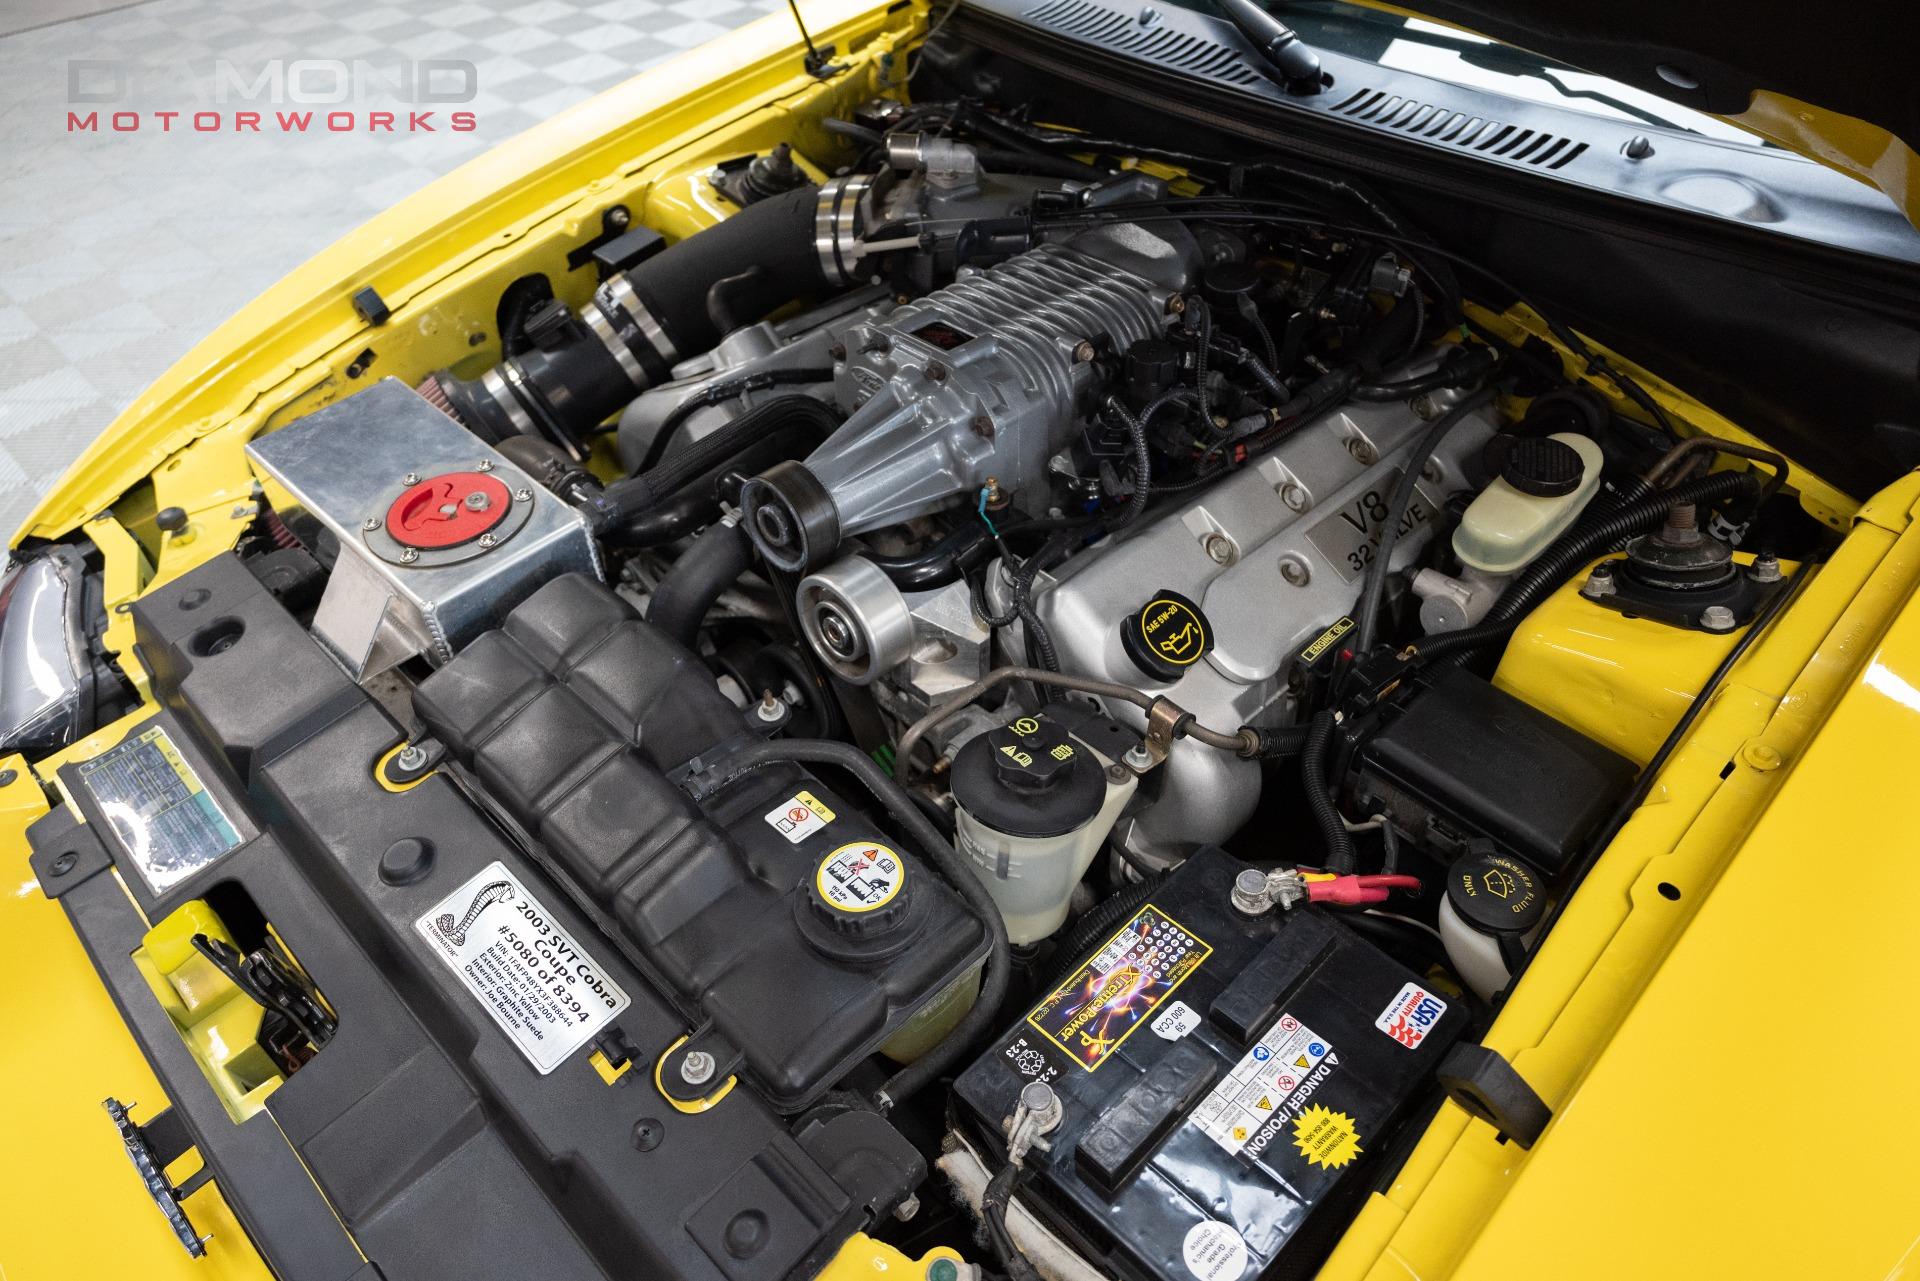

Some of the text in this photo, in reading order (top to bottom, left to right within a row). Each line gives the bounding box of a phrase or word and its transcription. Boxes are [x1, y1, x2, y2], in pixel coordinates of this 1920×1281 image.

[1339, 491, 1389, 535] V8
[1347, 544, 1375, 572] 32
[1146, 604, 1177, 633] SAE 5W-20
[1308, 623, 1347, 654] ENGINE OIL
[1463, 875, 1477, 897] ONLY
[1511, 892, 1534, 913] FLUID
[495, 940, 508, 956] VIN:
[516, 901, 616, 1008] 2003 SVT Cobra
[534, 939, 575, 985] Coupe
[479, 952, 539, 1020] Exterior: Zinc Yellow
[486, 946, 556, 1023] Build Date: 01/29/2003
[498, 925, 589, 1022] #5080 of 8394
[464, 964, 520, 1029] Owner: Joe Bourne
[471, 958, 543, 1040] Interior: Graphite Suede
[1402, 991, 1424, 1016] QUALITY
[1061, 1008, 1095, 1041] Power
[1156, 1006, 1185, 1032] 600 CCA
[1411, 998, 1442, 1025] USA
[1174, 1022, 1186, 1032] 59
[1006, 1038, 1027, 1057] B-23
[1289, 1065, 1331, 1109] DANGER
[1313, 1125, 1339, 1150] WARRANTY
[1319, 1131, 1348, 1159] NATIONWIDE
[1190, 1229, 1211, 1250] Choice
[1207, 1243, 1225, 1263] Grade
